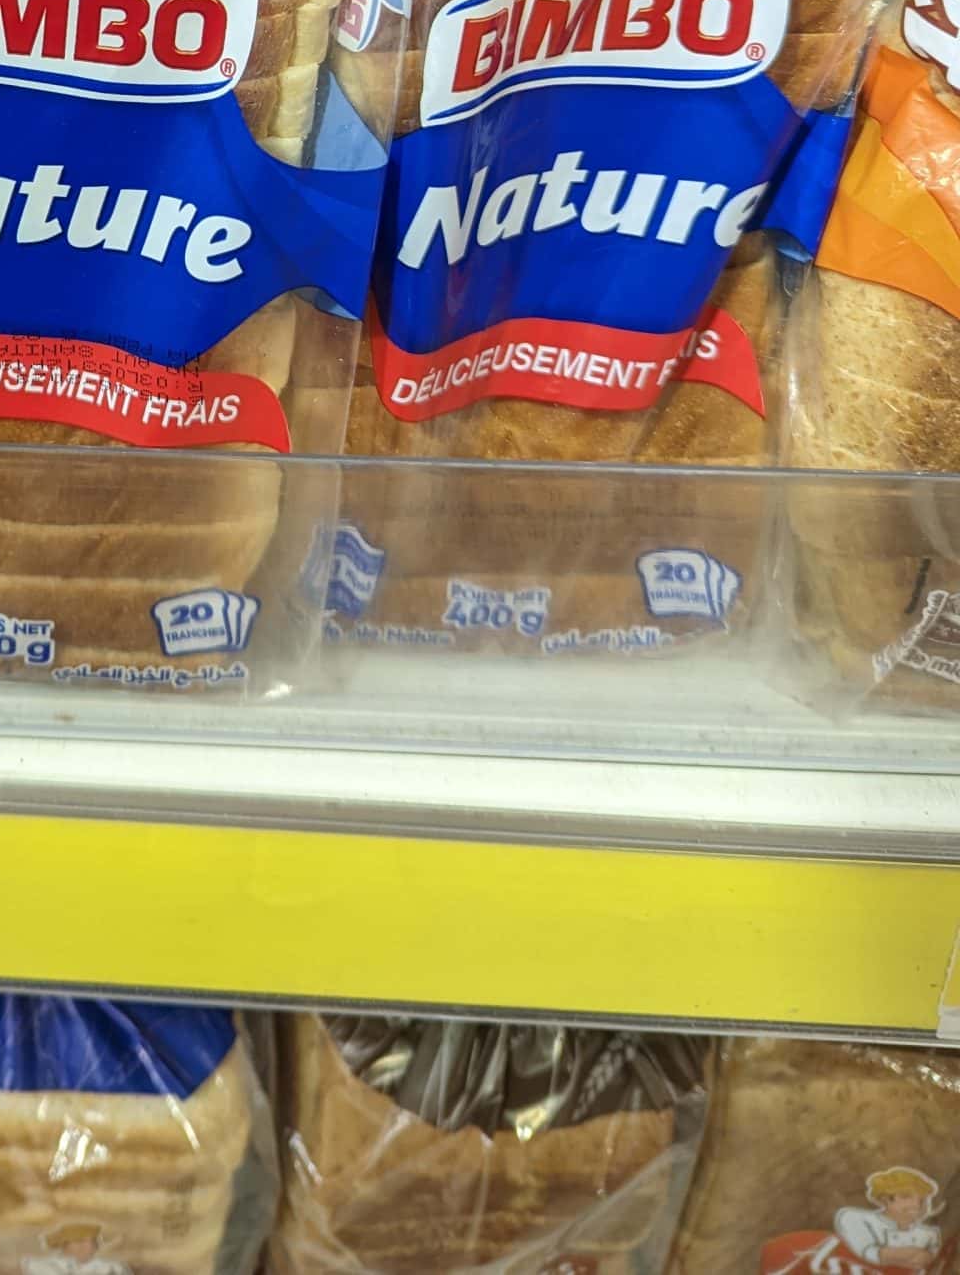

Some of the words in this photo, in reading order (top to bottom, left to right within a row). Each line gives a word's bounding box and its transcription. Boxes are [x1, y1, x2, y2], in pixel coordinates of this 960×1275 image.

[396, 151, 769, 270] Nature
[391, 341, 655, 405] DÉLICIEUSEMENT
[143, 392, 240, 430] FRAIS
[656, 561, 696, 583] 20
[171, 602, 214, 624] 20
[446, 604, 512, 628] 400
[520, 611, 545, 635] g
[13, 622, 51, 636] NET
[27, 640, 52, 663] g
